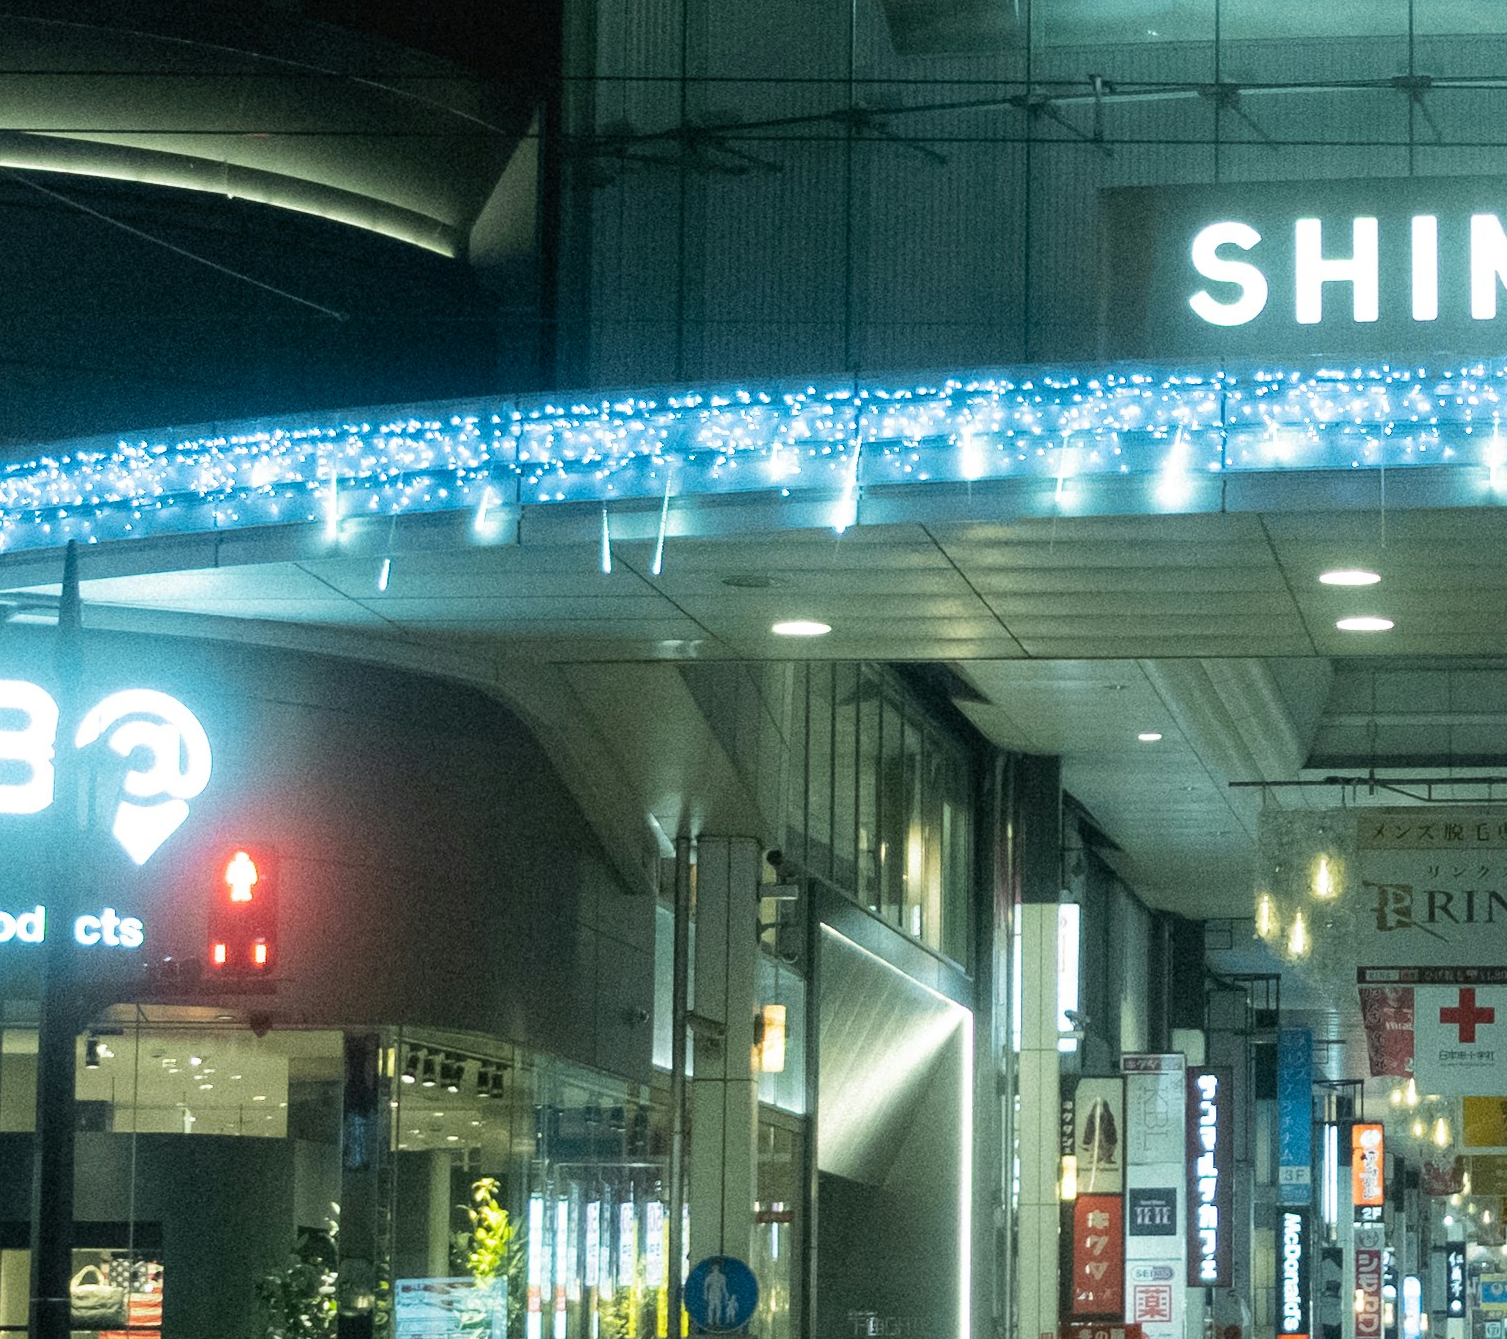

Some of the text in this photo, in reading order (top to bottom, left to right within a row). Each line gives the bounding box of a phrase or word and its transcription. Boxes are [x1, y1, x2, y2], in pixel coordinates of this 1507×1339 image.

[1143, 1087, 1169, 1152] KBL
[1284, 1169, 1305, 1179] 3F
[1361, 1207, 1383, 1219] 2F
[1283, 1213, 1303, 1333] McDonald's
[1137, 1287, 1168, 1319] 薬
